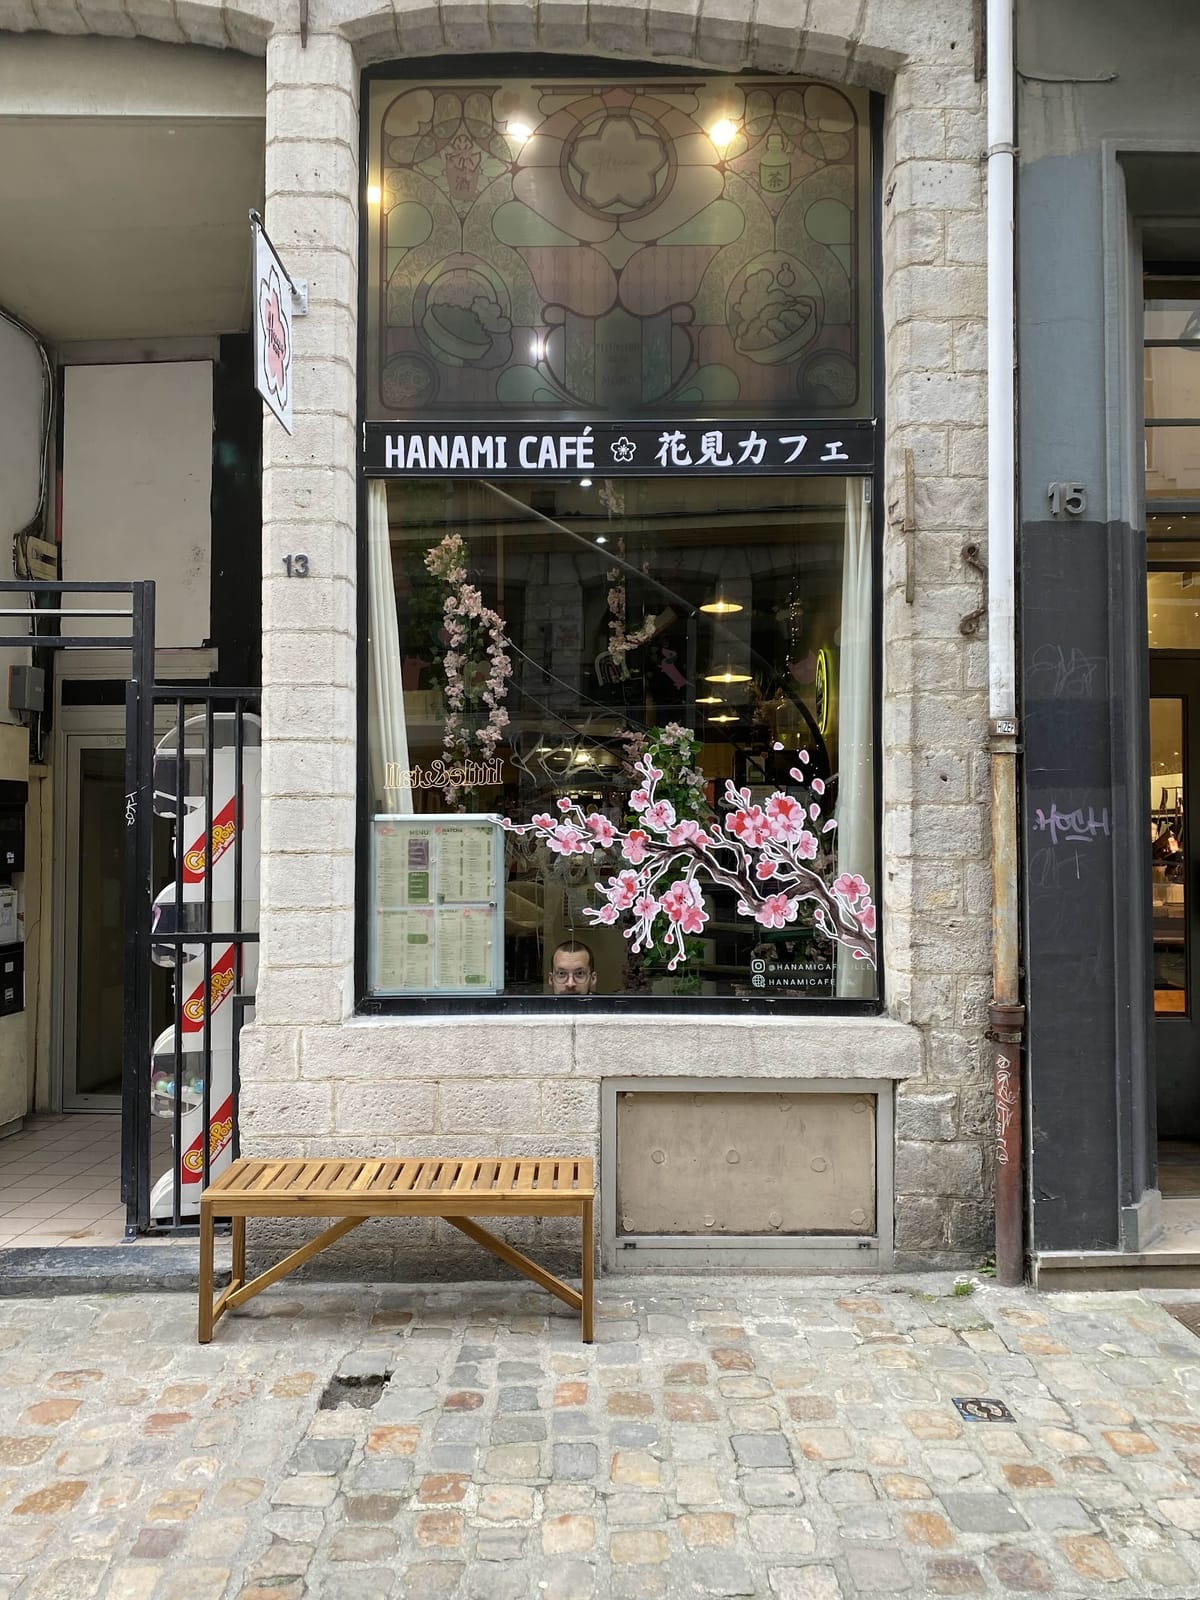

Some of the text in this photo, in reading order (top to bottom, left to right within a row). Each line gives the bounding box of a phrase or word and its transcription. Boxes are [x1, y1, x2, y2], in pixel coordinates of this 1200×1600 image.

[385, 426, 595, 469] HANAMI CAFÉ
[655, 430, 849, 467] 花見カフェ
[1047, 482, 1086, 515] 15
[282, 553, 309, 578] 13
